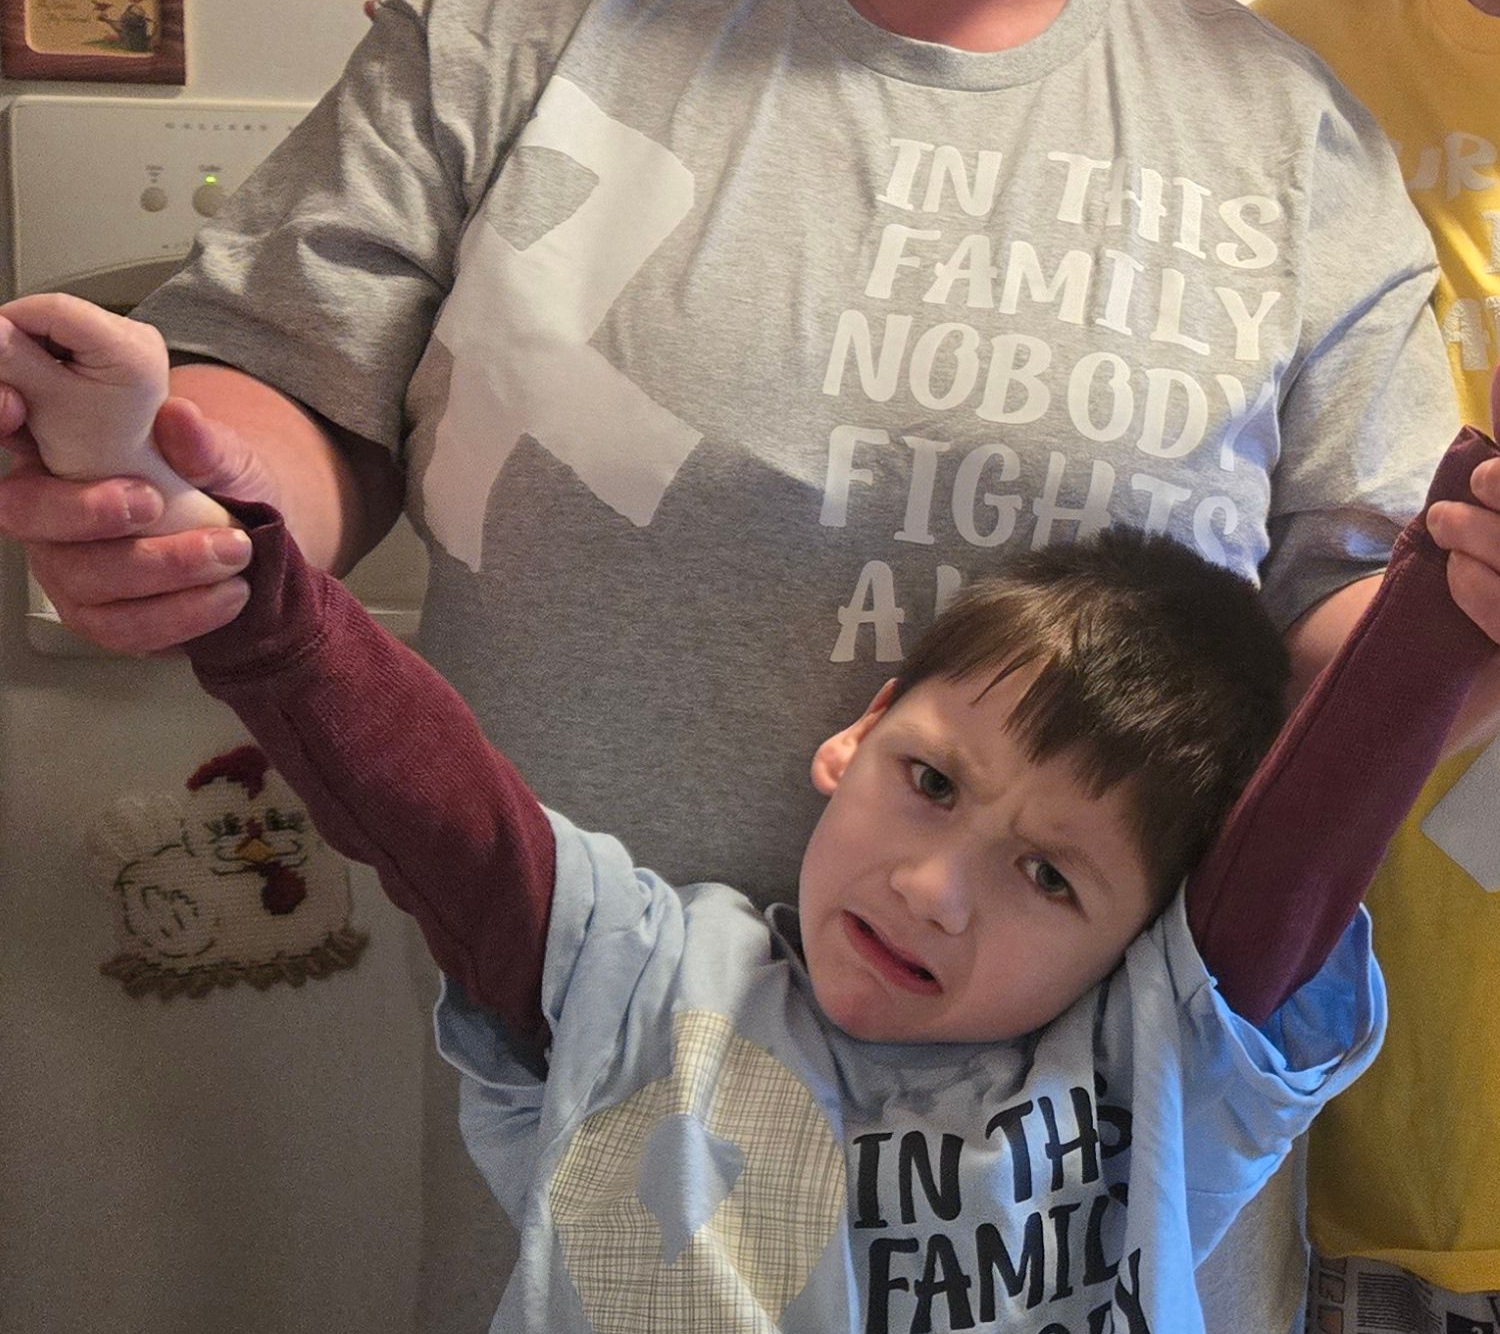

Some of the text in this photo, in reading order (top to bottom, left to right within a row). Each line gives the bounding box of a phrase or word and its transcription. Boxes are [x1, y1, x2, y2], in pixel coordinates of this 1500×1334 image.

[876, 138, 1281, 269] IN THIS
[864, 223, 1280, 361] FAMILY
[819, 425, 1238, 567] FIGHTS
[853, 1130, 964, 1229] IN
